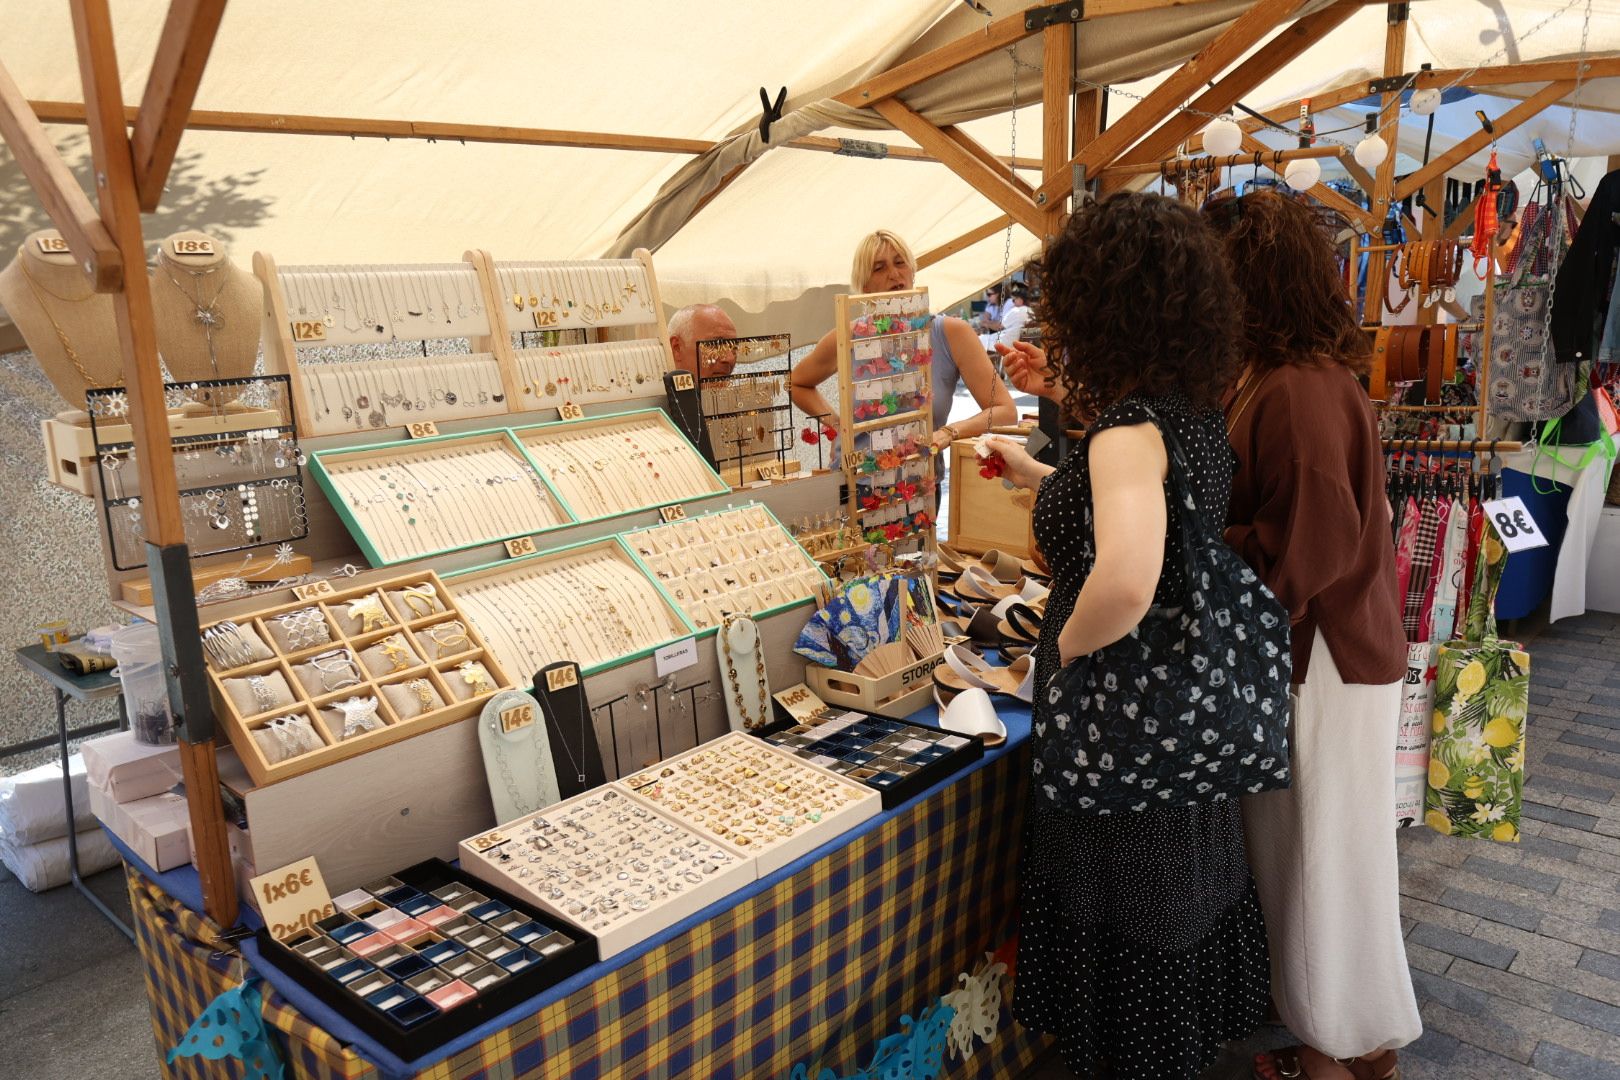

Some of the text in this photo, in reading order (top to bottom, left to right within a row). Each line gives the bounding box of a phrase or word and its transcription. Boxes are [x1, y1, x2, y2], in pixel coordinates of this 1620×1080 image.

[43, 239, 67, 250] 18
[177, 241, 210, 251] 18€
[536, 311, 557, 326] 12€
[295, 322, 322, 339] 12€
[675, 375, 692, 389] 14€
[562, 405, 580, 419] 8€
[412, 423, 434, 437] 8€
[760, 466, 778, 478] 10€
[663, 505, 685, 520] 12€
[1495, 510, 1534, 538] 8€
[510, 538, 532, 556] 8€
[296, 582, 330, 600] 14€
[549, 667, 575, 690] 14€
[781, 688, 810, 707] 1x6€
[504, 706, 532, 731] 14€
[627, 774, 650, 786] 8€
[475, 832, 503, 848] 8€
[263, 868, 313, 904] 1x6€
